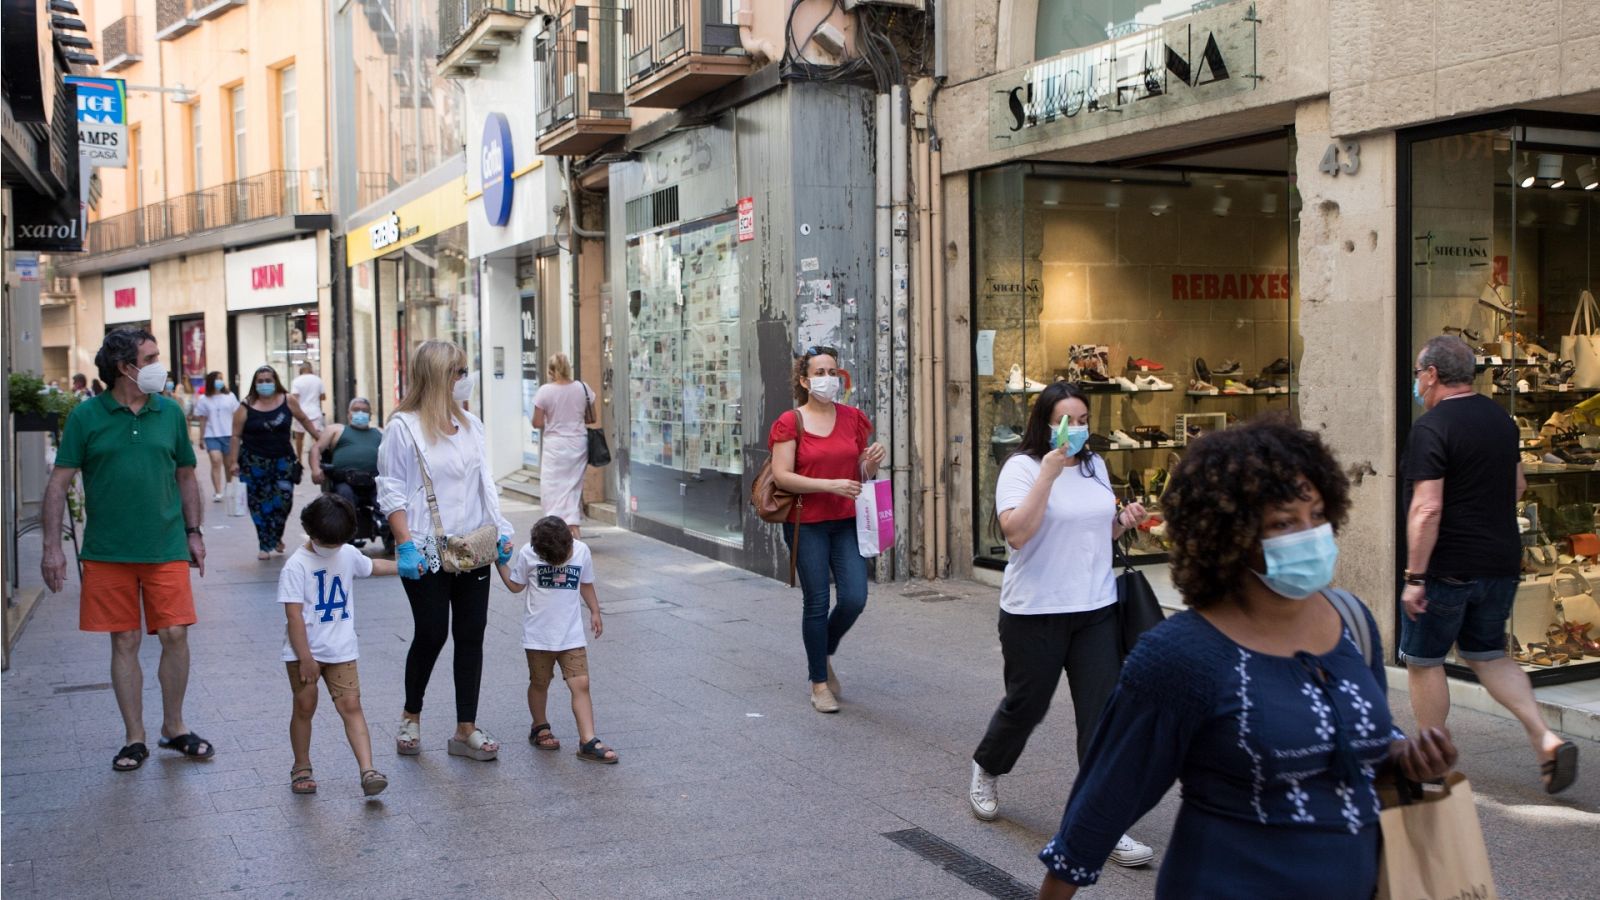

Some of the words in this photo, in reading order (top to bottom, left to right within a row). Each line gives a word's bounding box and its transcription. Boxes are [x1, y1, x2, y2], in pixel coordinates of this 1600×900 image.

[79, 130, 118, 146] AMPS
[90, 150, 118, 159] CASA
[1319, 141, 1361, 177] 43
[18, 219, 77, 239] xarol
[1172, 273, 1289, 299] REBAIXES
[538, 565, 580, 576] CALIFORNIA
[313, 569, 349, 622] LA
